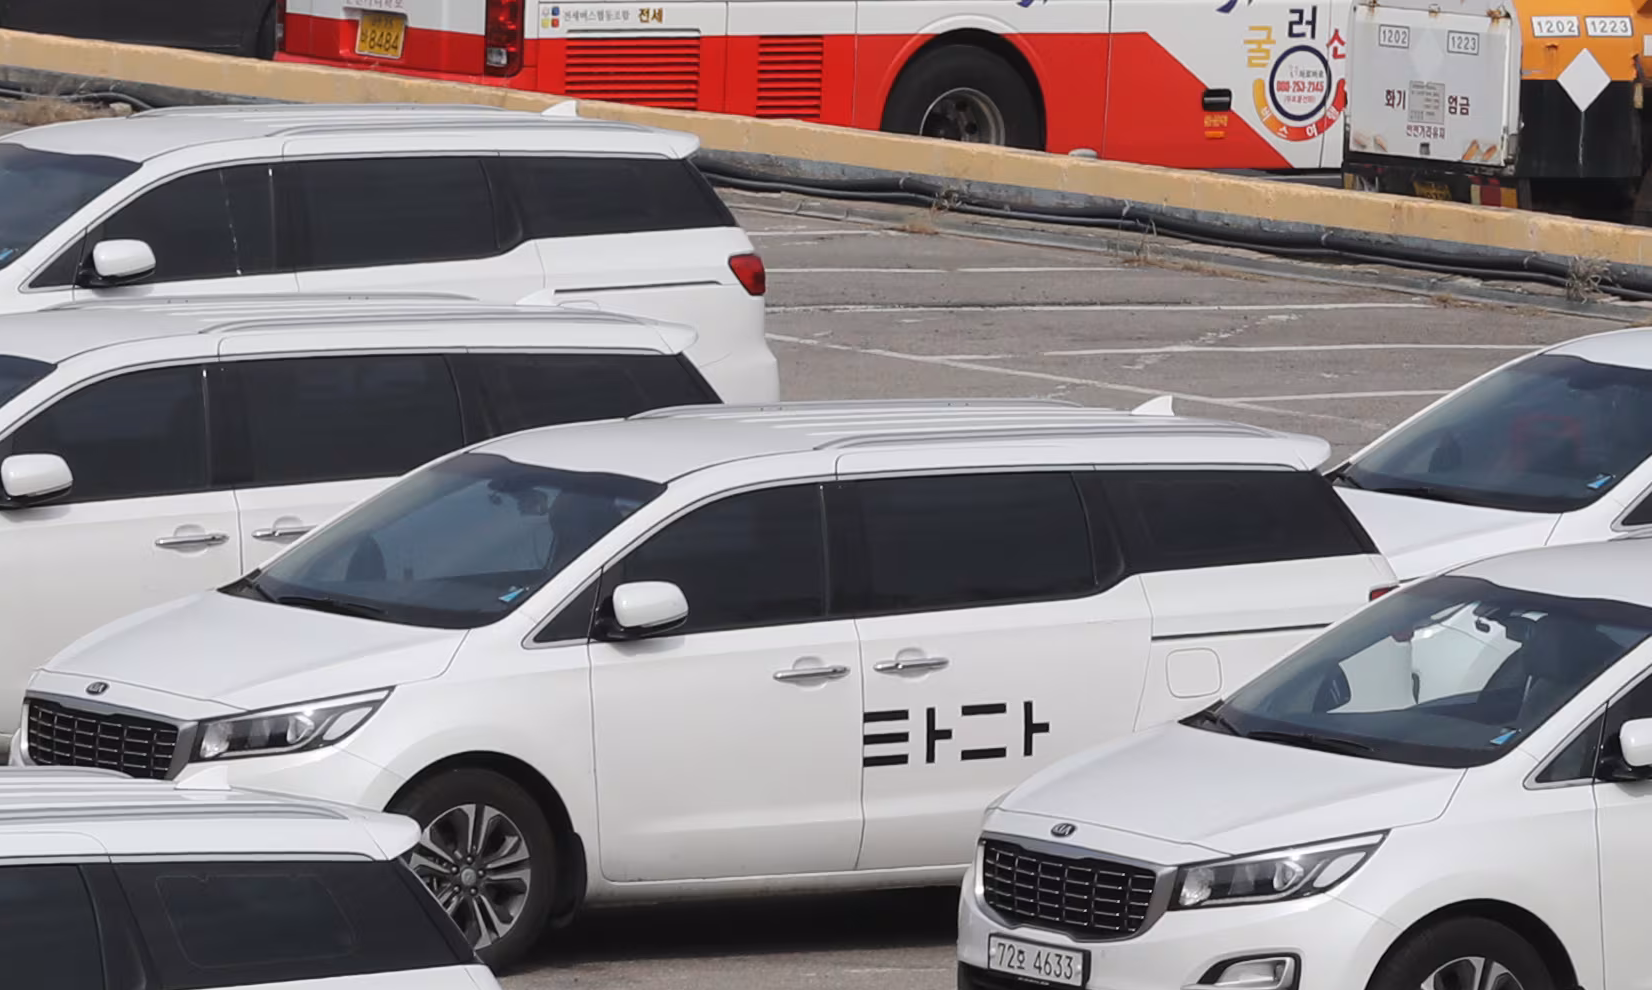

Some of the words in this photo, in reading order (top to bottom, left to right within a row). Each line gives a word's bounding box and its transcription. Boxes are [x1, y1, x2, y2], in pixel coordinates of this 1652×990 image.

[1537, 20, 1576, 33] 1202
[1591, 20, 1629, 33] 1223
[1382, 29, 1408, 45] 1202
[1451, 36, 1477, 51] 1223
[1385, 89, 1406, 110] 화기
[1448, 95, 1470, 116] 엄금
[998, 942, 1025, 970] 72호
[1033, 950, 1074, 980] 4633
